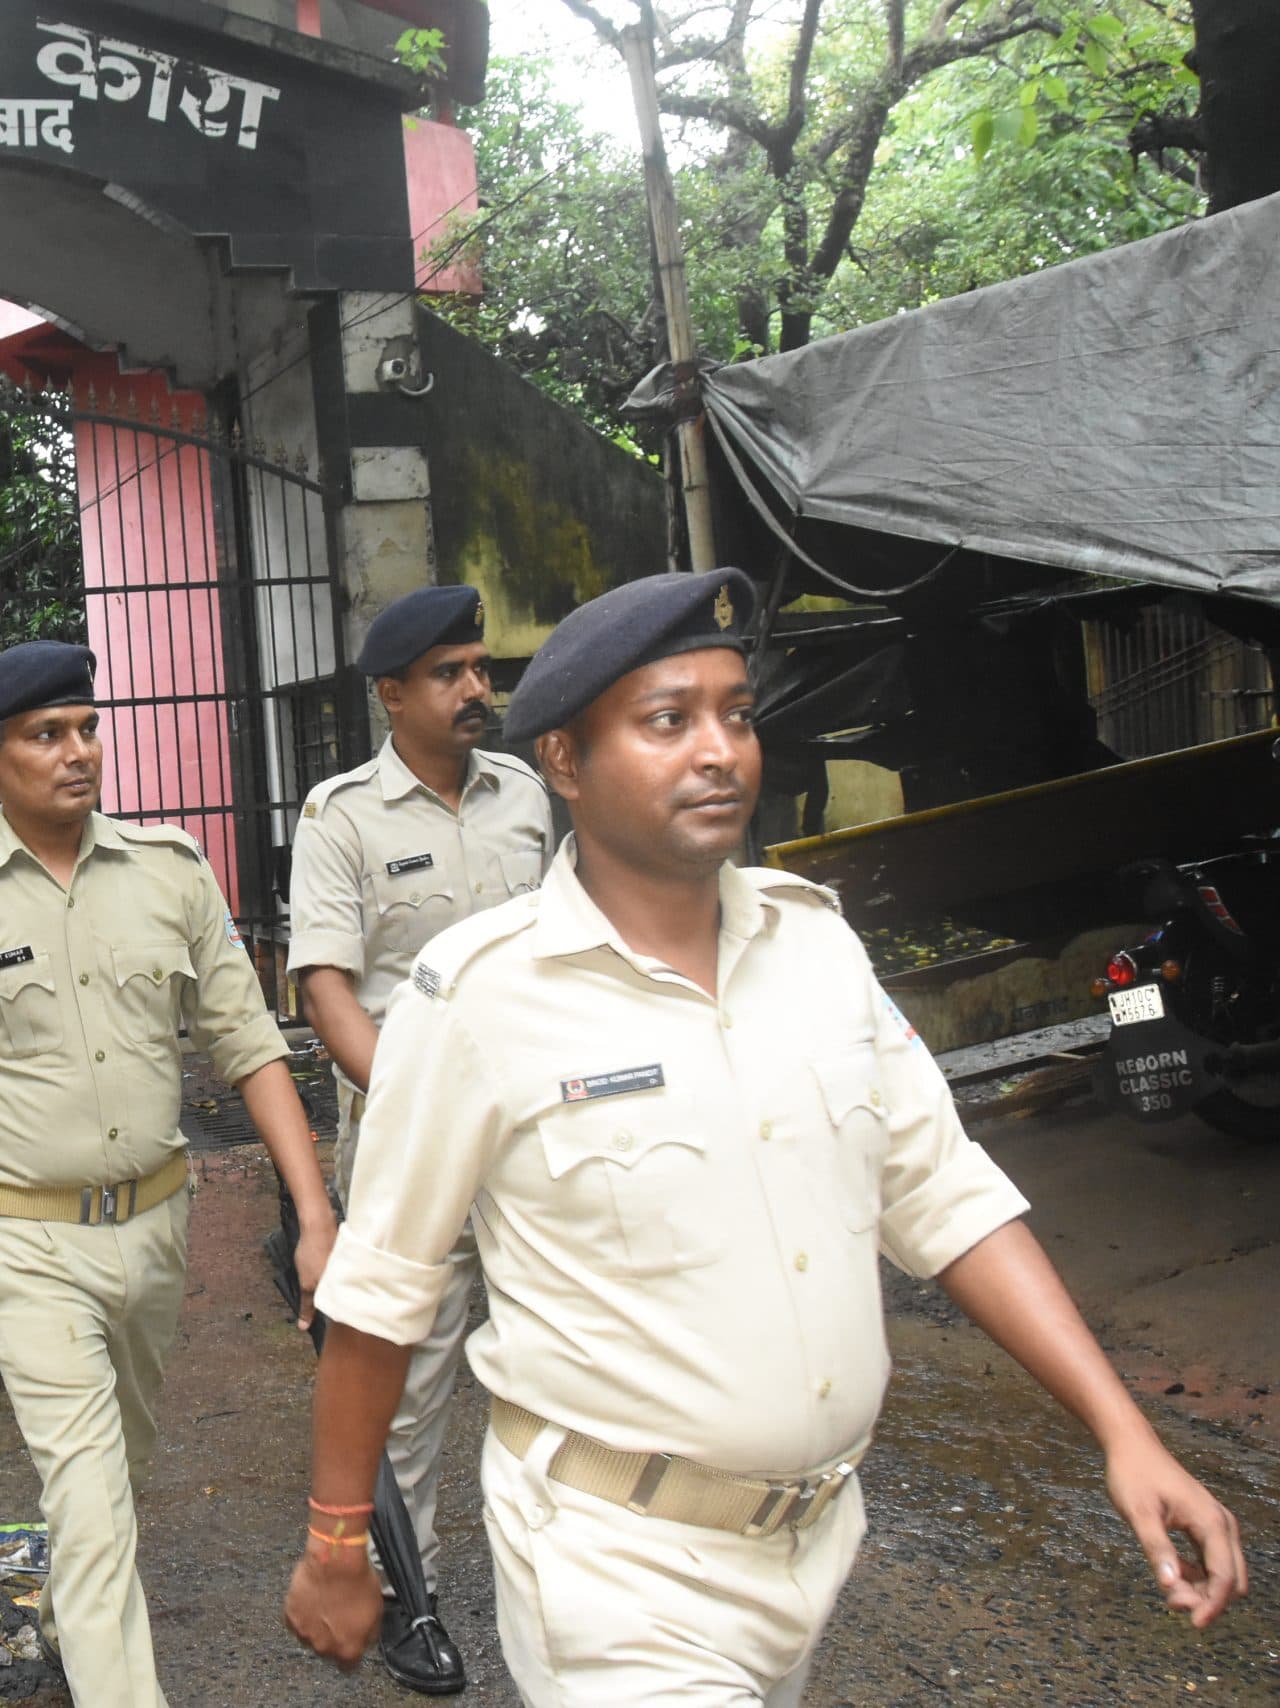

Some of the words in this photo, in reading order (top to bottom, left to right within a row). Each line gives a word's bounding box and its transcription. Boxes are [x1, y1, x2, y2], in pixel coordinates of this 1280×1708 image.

[1115, 1049, 1188, 1076] REBORN
[1120, 1069, 1193, 1095] CLASSIC
[1141, 1093, 1172, 1112] 350
